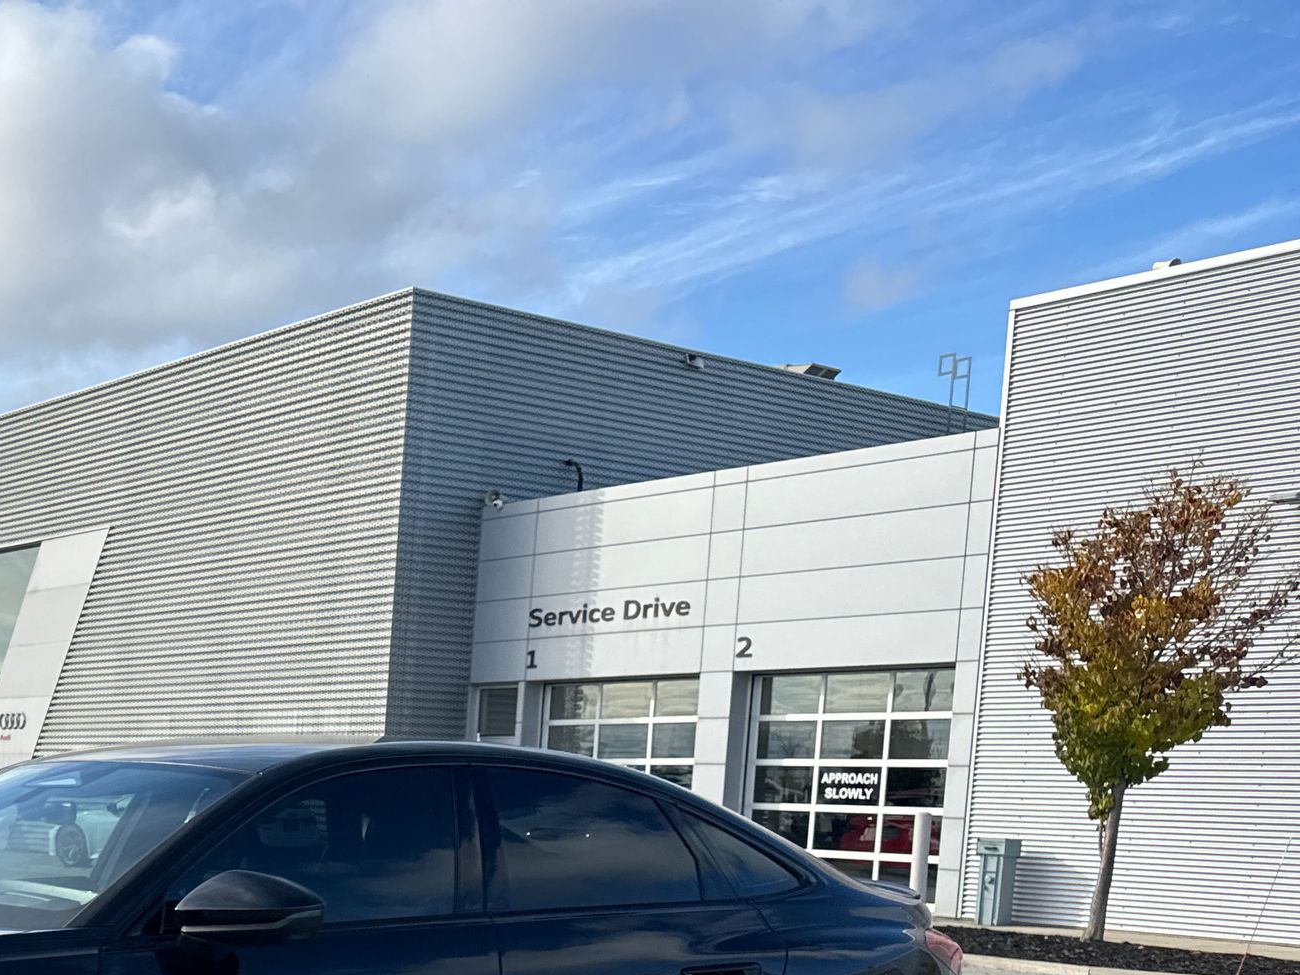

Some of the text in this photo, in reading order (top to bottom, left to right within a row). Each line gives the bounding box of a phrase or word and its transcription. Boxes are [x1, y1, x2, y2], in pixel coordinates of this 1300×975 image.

[528, 597, 691, 627] Service Drive
[735, 637, 753, 658] 2
[526, 650, 537, 669] 1
[821, 772, 878, 785] APPROACH
[824, 787, 874, 800] SLOWLY
